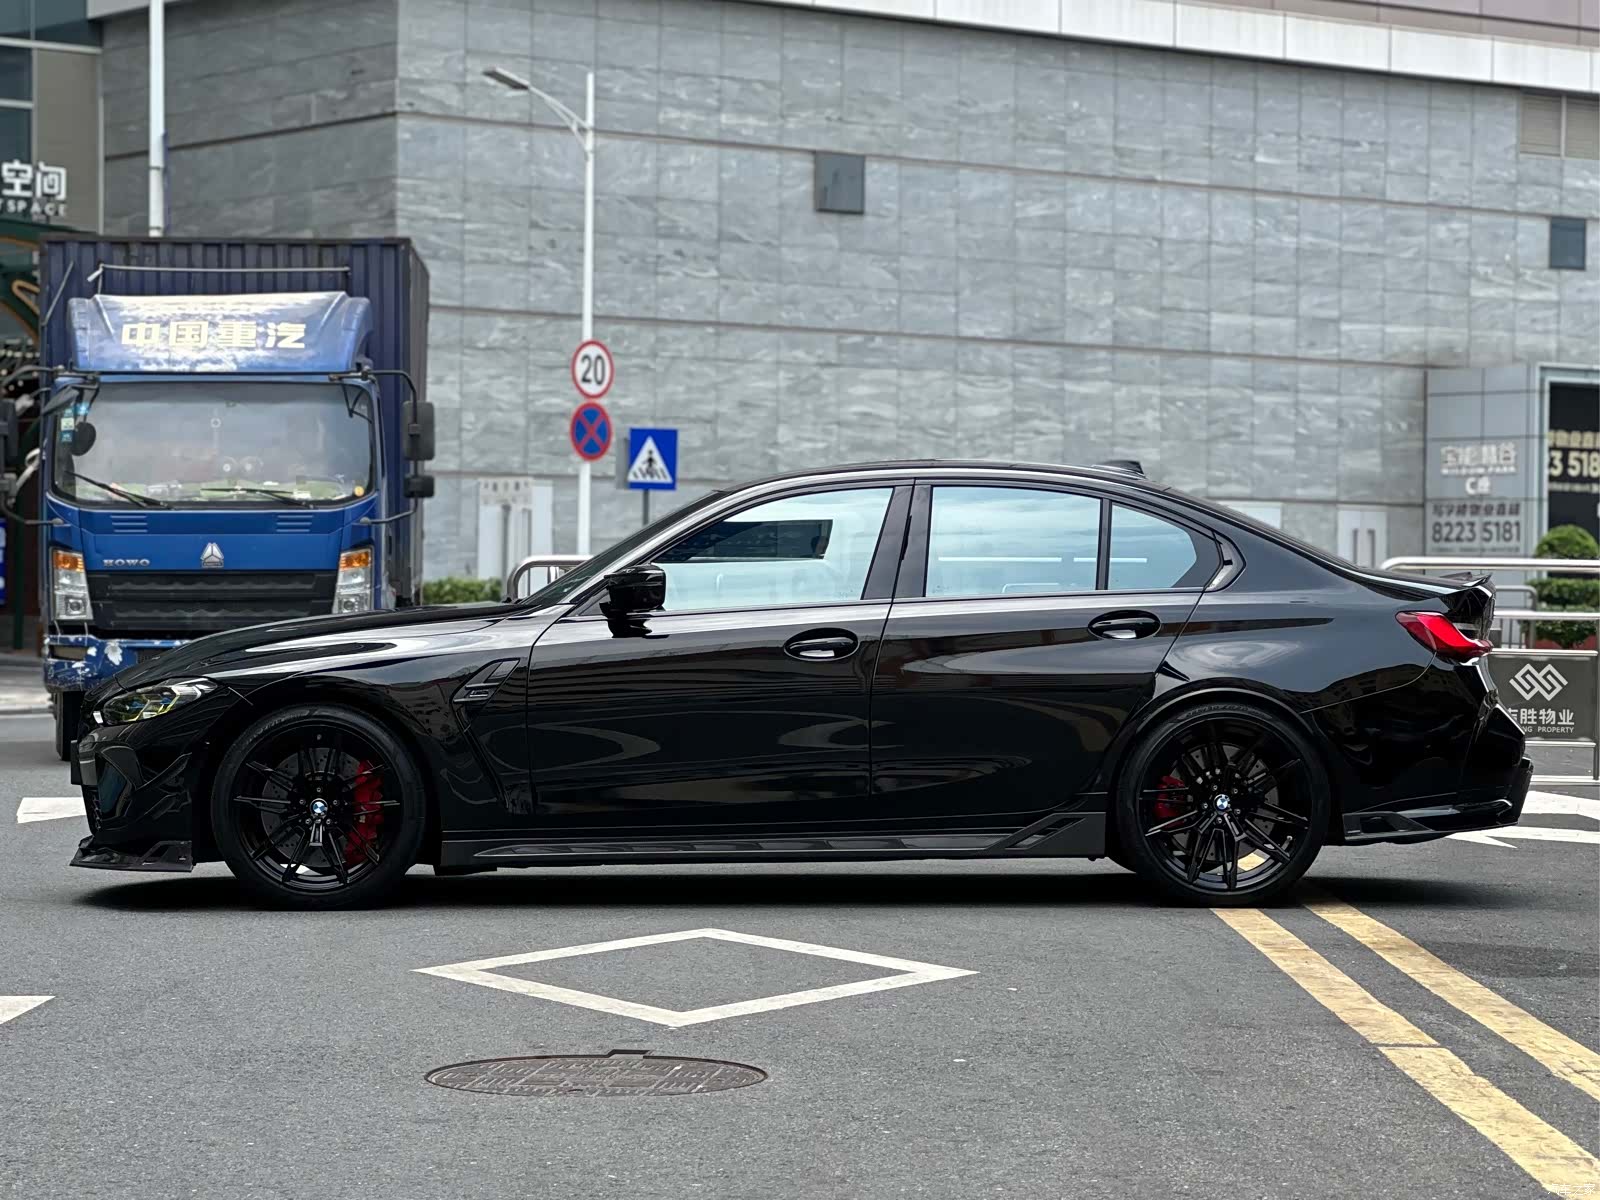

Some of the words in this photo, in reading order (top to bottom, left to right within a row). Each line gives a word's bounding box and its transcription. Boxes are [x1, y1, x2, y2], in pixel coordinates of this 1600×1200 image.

[1, 159, 67, 200] 空间
[121, 321, 306, 349] 中国重汽
[581, 354, 606, 385] 20
[1432, 521, 1476, 543] 8223
[1482, 520, 1521, 543] 5181
